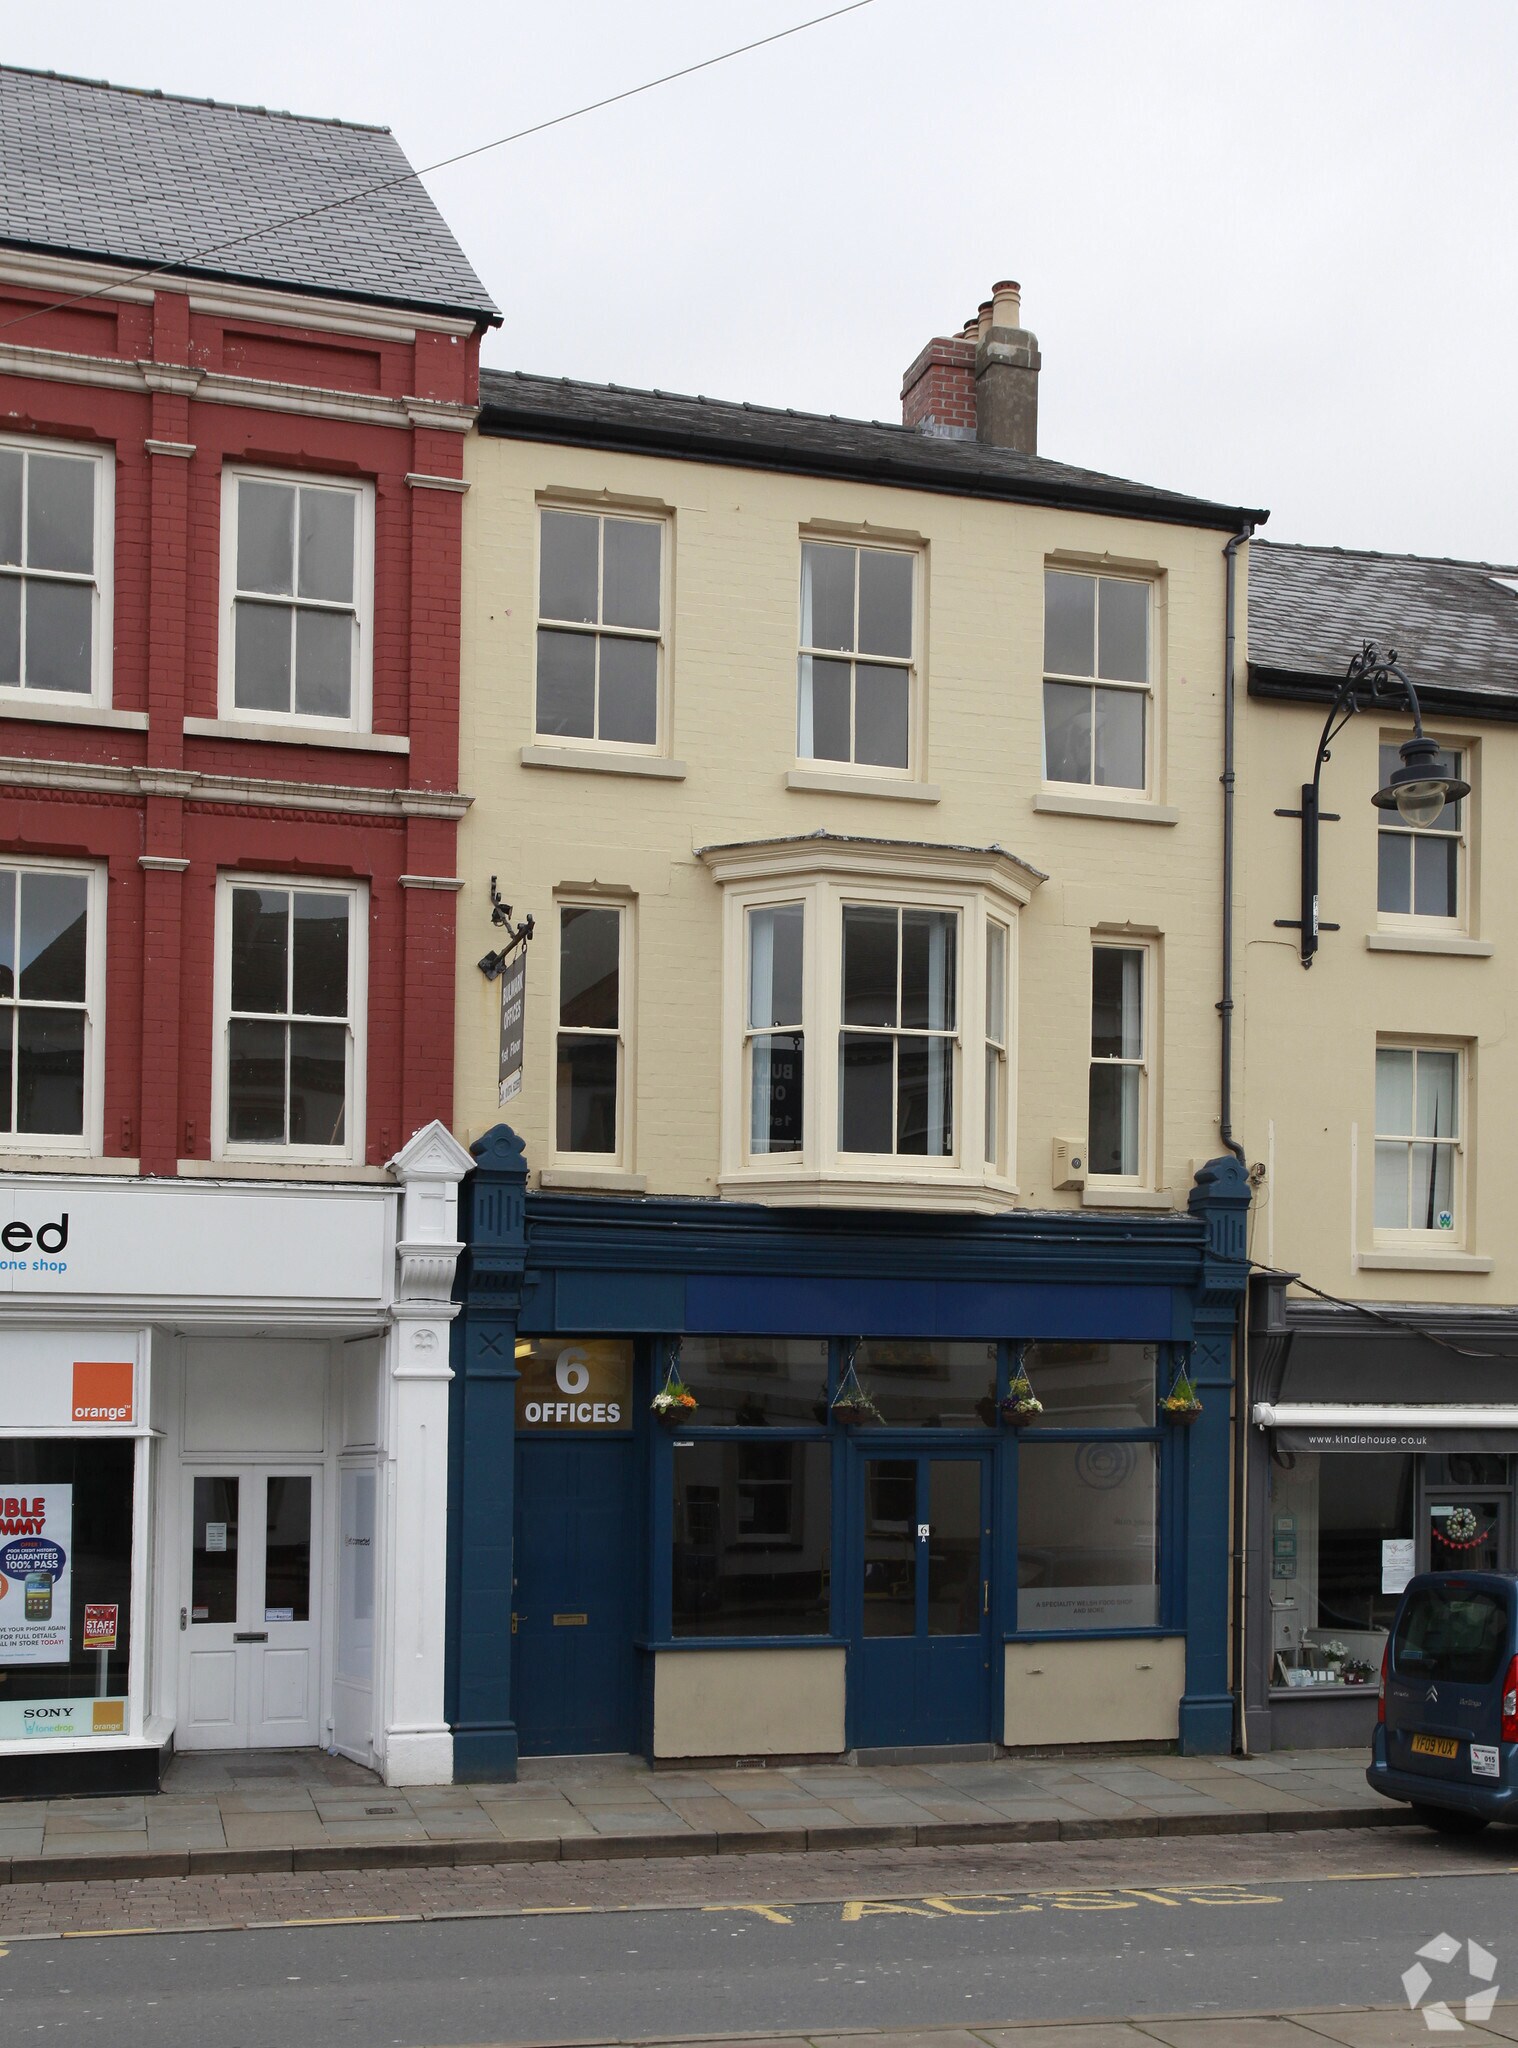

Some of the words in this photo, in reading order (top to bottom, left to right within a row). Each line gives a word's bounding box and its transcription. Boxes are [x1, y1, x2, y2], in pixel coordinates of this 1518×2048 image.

[503, 999, 521, 1030] OFFICES
[501, 1047, 509, 1063] 1st
[510, 1039, 521, 1057] Floor
[1, 1212, 69, 1254] ed
[32, 1258, 67, 1274] shop
[555, 1346, 590, 1395] 6
[74, 1407, 126, 1421] orange
[525, 1402, 621, 1423] OFFICES
[1309, 1434, 1427, 1445] www.kindlehouse.co.uk
[920, 1526, 927, 1535] 6
[6, 1560, 31, 1569] 100%
[34, 1560, 59, 1568] PASS
[86, 1620, 115, 1629] STAFF
[24, 1707, 74, 1718] SONY
[94, 1723, 121, 1731] orange
[1416, 1735, 1436, 1752] YF09
[1437, 1739, 1455, 1756] YUX
